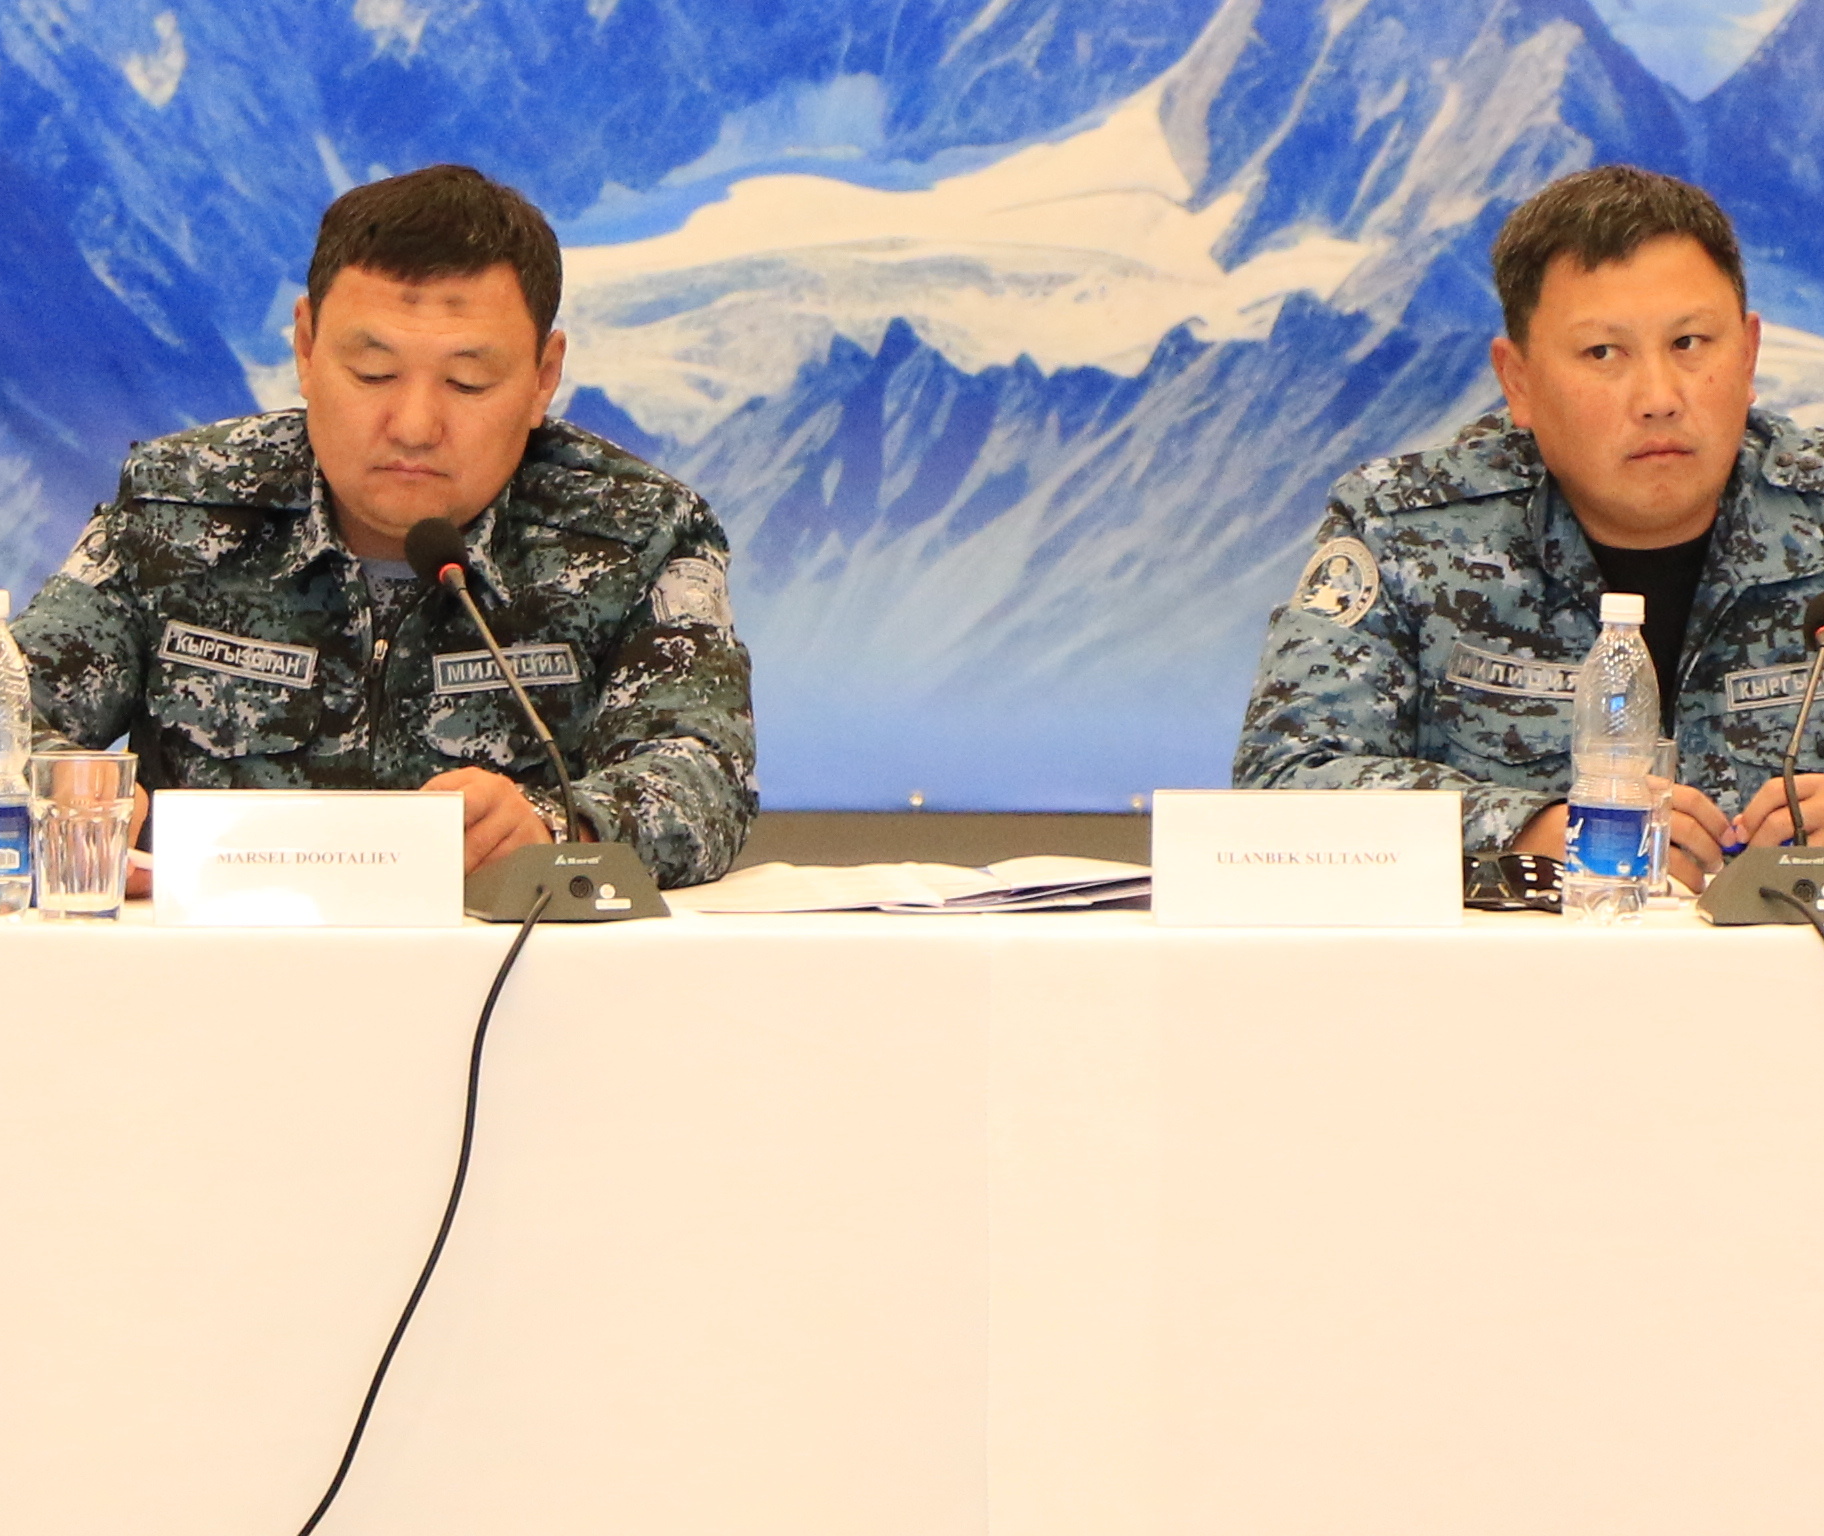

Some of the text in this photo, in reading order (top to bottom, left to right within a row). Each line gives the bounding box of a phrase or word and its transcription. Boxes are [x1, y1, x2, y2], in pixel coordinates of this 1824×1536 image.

[216, 851, 401, 865] MARSEL DOOTALIEV
[1216, 851, 1401, 865] ULANBEK SULTANOV
